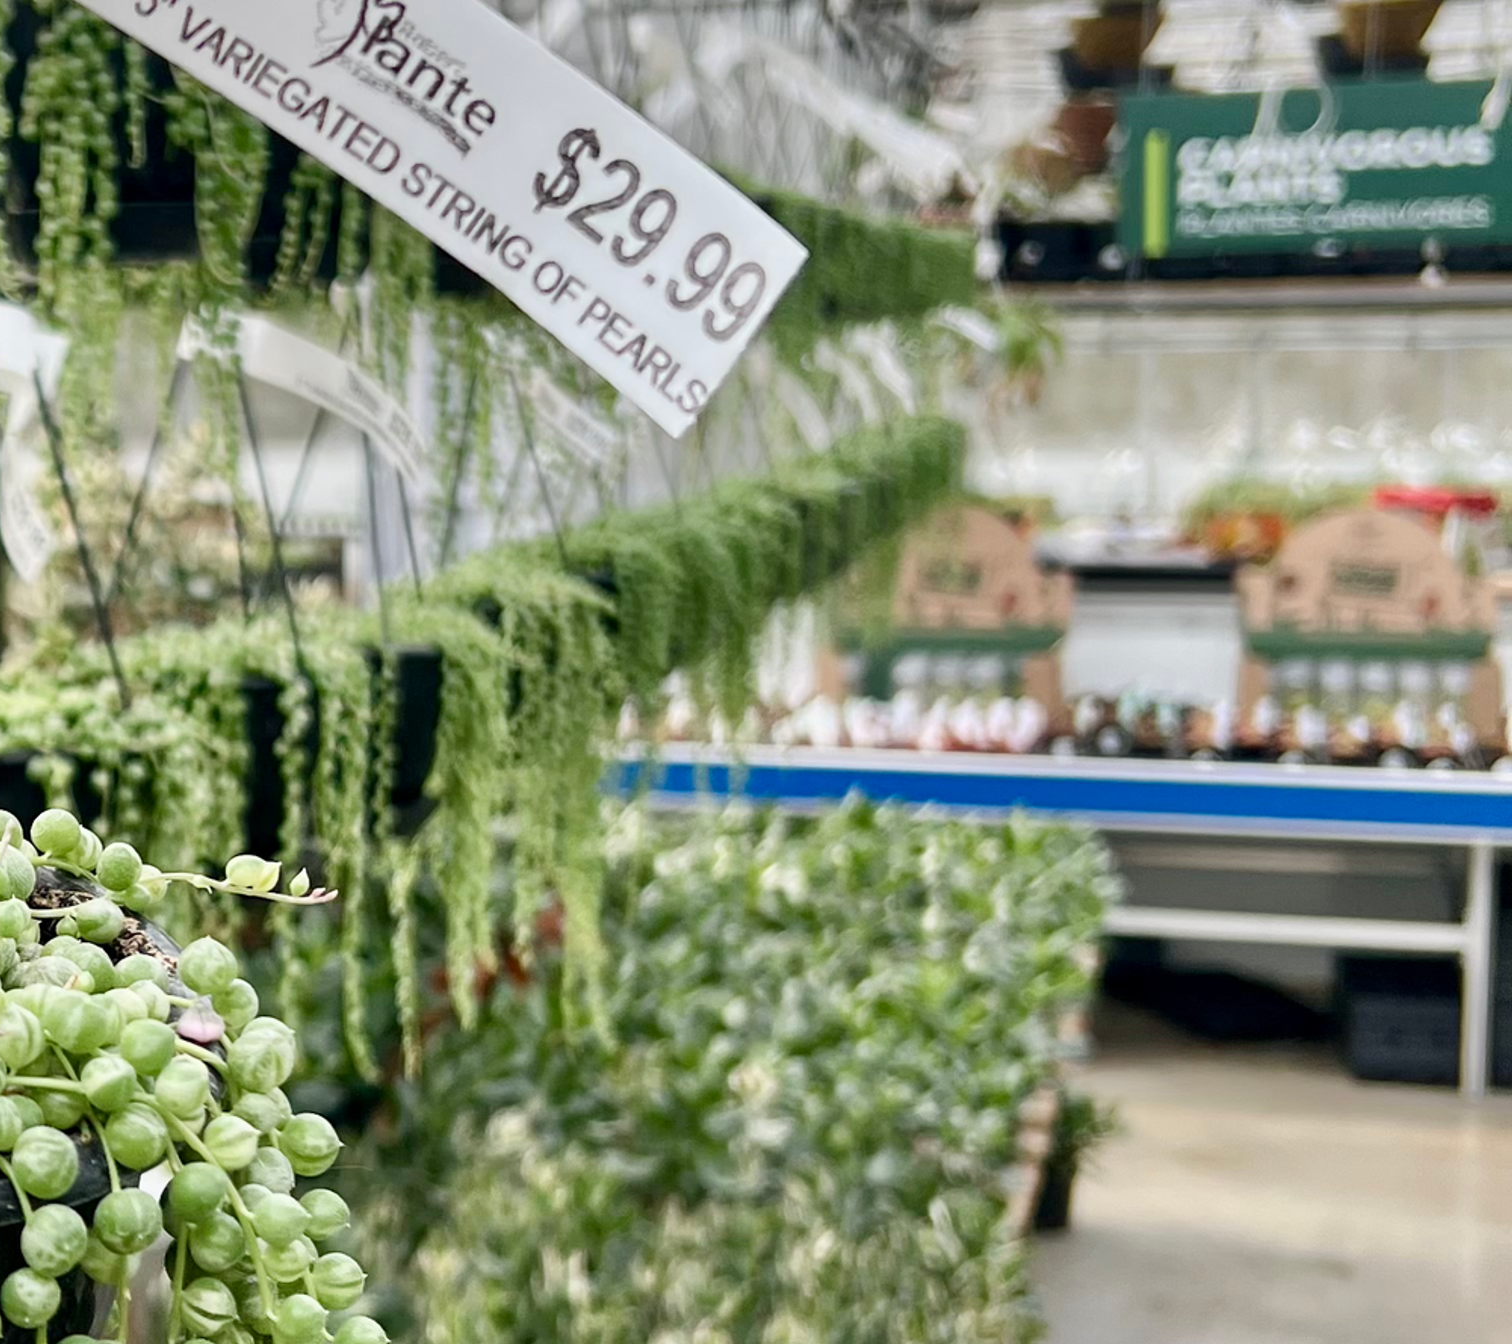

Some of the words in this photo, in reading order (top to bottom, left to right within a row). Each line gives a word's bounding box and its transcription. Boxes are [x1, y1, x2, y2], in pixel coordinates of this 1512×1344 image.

[179, 6, 400, 174] VARIEGATED
[401, 163, 533, 271] STRING
[534, 261, 587, 305] OF
[576, 297, 708, 413] PEARLS
[533, 128, 767, 343] $29.99
